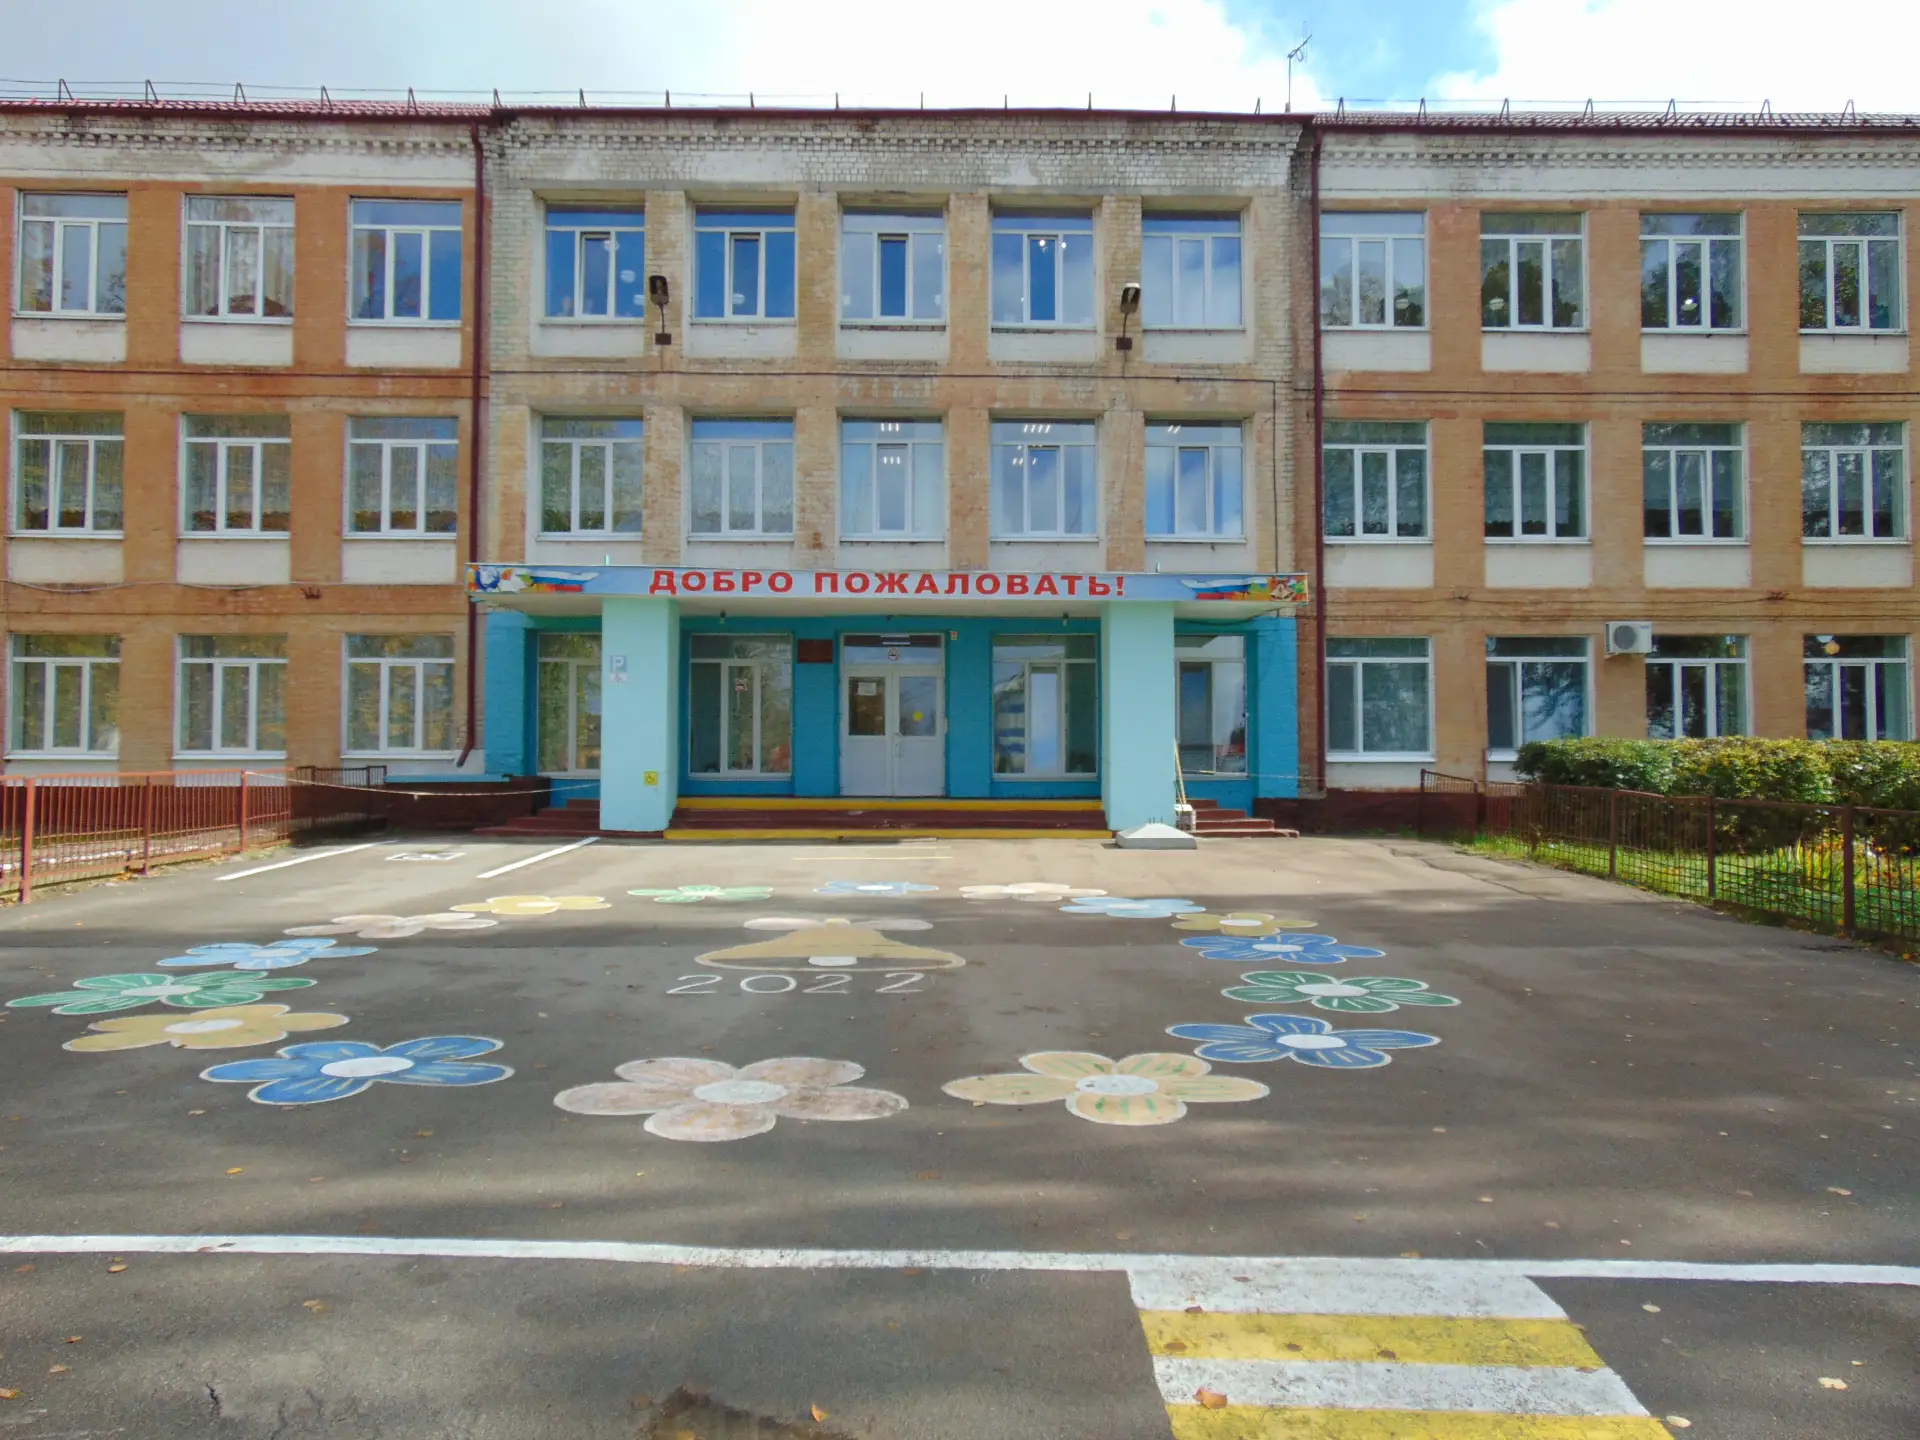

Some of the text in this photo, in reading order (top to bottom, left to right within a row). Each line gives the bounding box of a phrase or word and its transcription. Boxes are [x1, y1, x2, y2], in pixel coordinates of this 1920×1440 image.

[650, 570, 1124, 596] ДОБРО ПОЖАЛОВАТЬ!
[666, 973, 926, 995] 2022
